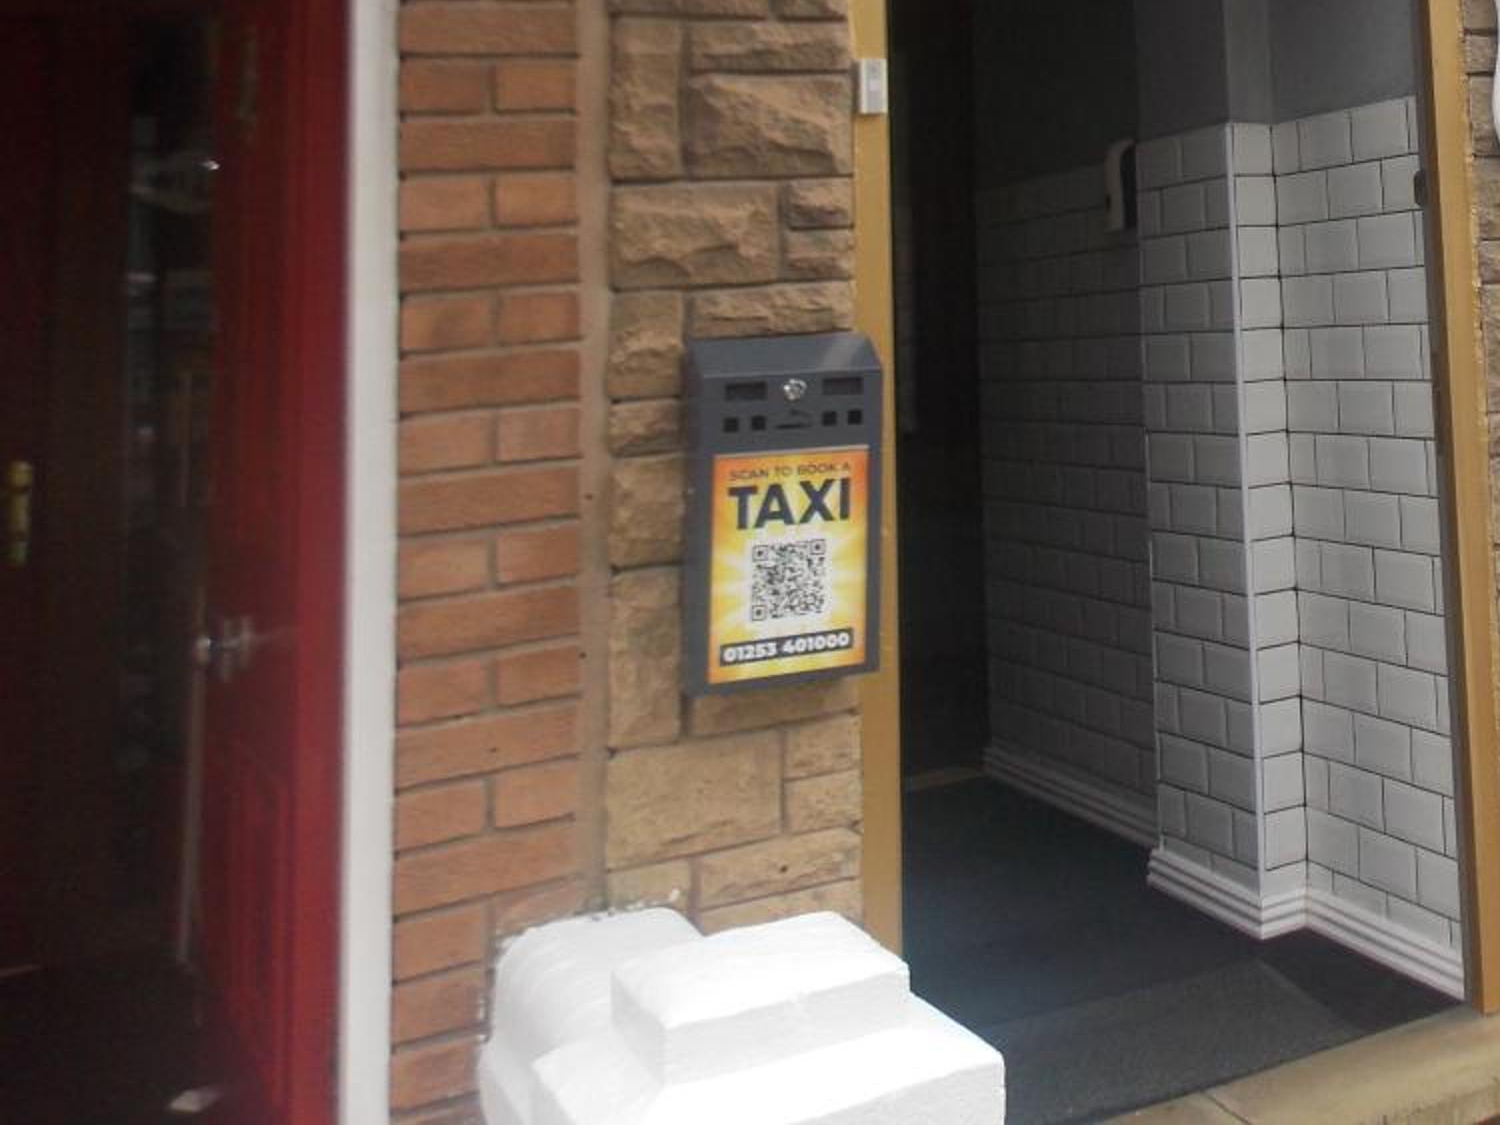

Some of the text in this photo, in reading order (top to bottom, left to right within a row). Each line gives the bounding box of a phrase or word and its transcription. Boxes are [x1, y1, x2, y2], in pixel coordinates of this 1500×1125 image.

[728, 476, 850, 529] TAXI
[722, 632, 850, 663] 01253 401000
